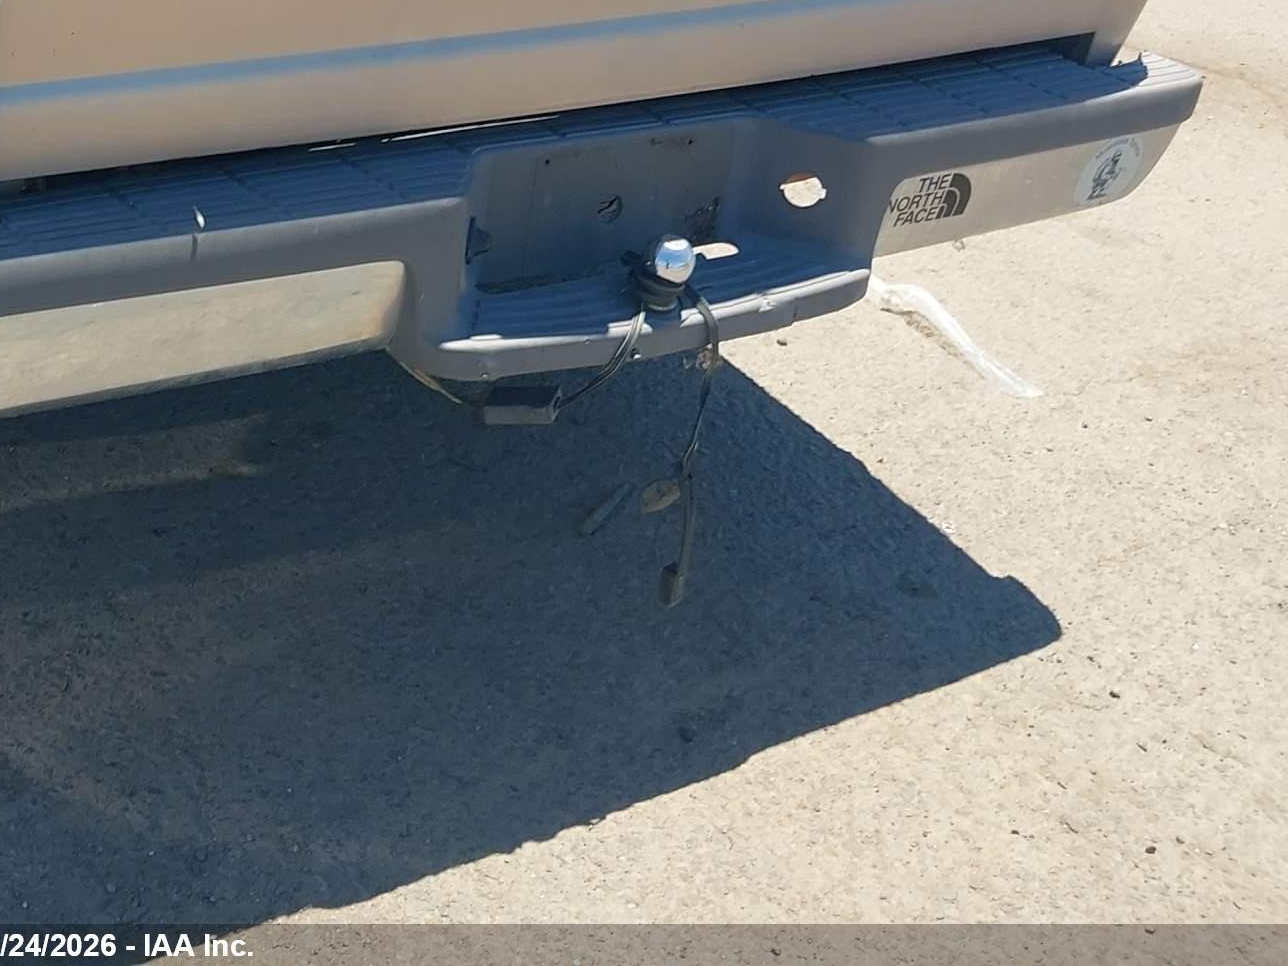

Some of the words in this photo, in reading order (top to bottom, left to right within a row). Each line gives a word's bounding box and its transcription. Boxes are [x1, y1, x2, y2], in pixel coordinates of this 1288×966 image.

[919, 174, 952, 193] THE
[888, 190, 945, 213] NORTH
[893, 206, 939, 227] FACE
